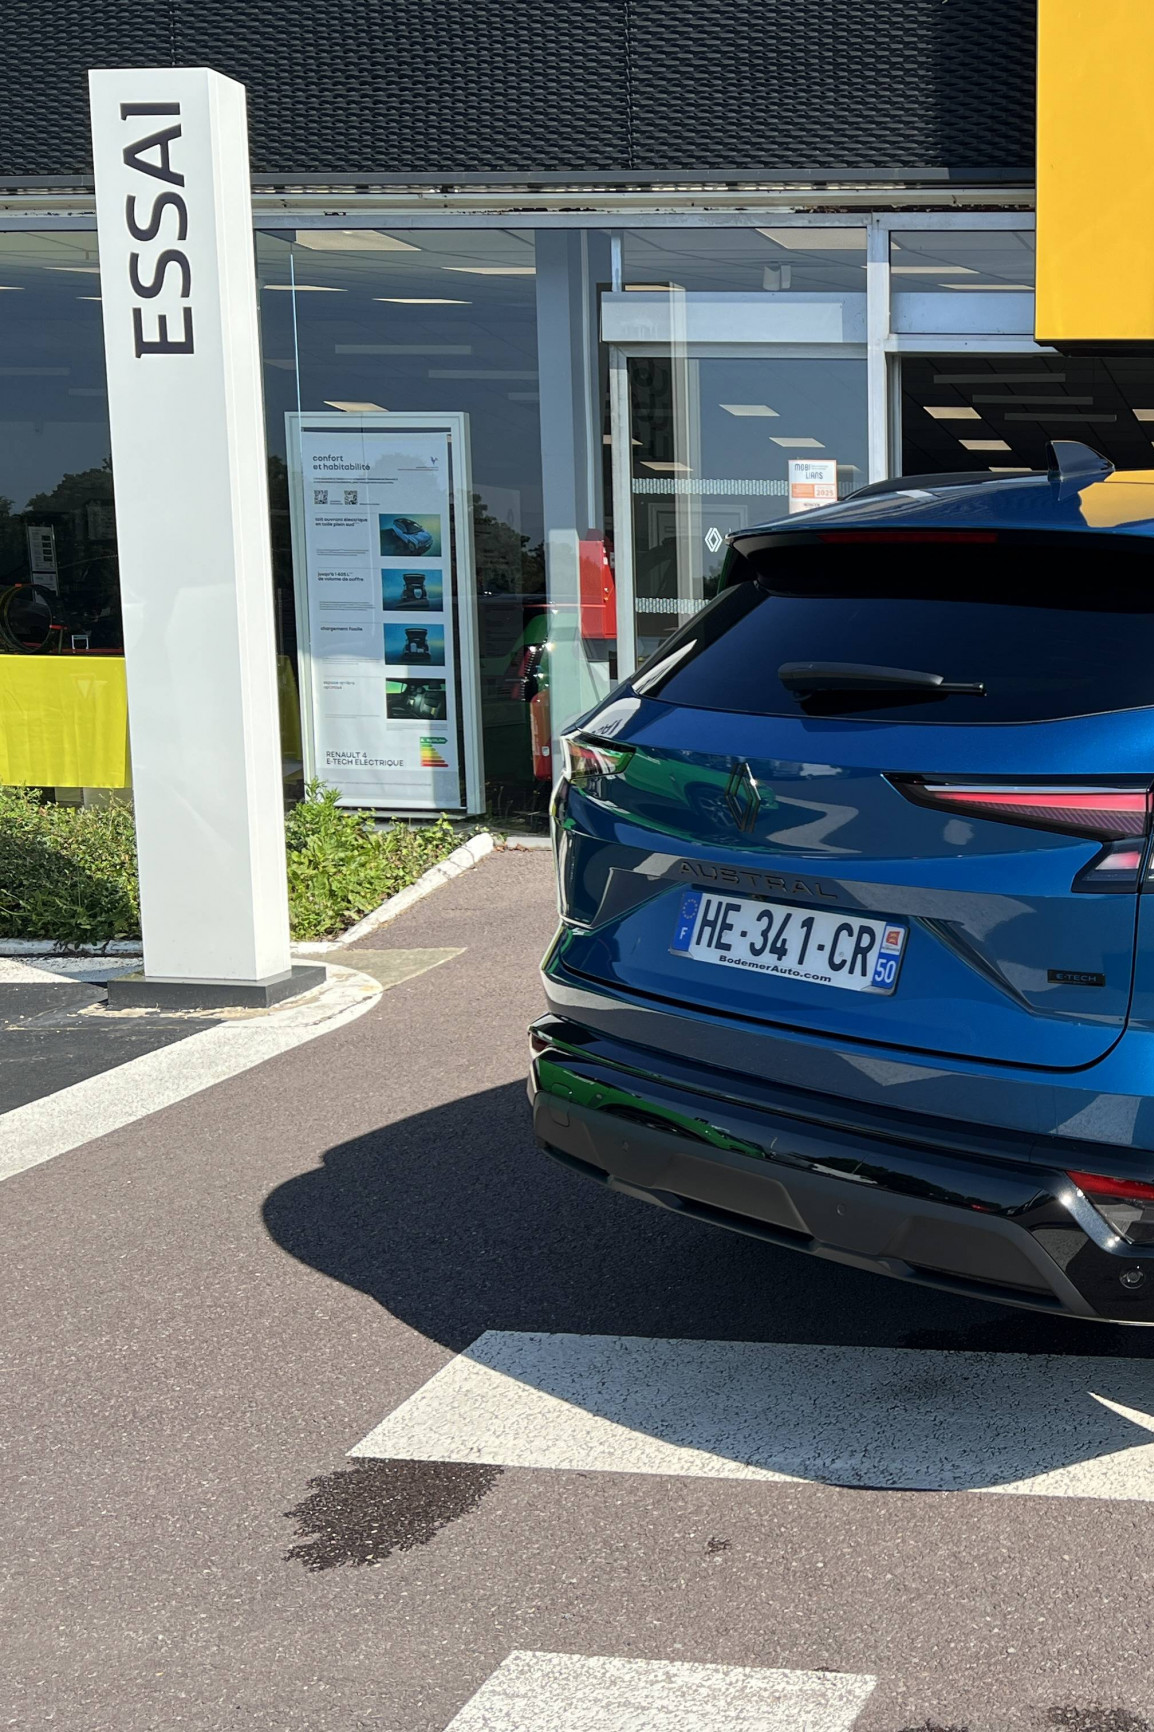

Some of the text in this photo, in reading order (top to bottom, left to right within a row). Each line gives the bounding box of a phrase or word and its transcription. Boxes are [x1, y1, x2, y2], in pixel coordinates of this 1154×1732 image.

[119, 102, 195, 359] ESSAI
[312, 454, 344, 462] confort
[312, 463, 371, 471] et habitabilité
[794, 463, 811, 471] MOBI
[325, 750, 361, 758] RENAULT
[679, 861, 839, 899] AUSTRAL
[678, 899, 897, 984] F HE-341-CR 50
[718, 954, 832, 983] BodemerAuto.com
[1055, 972, 1097, 982] E-TECH
